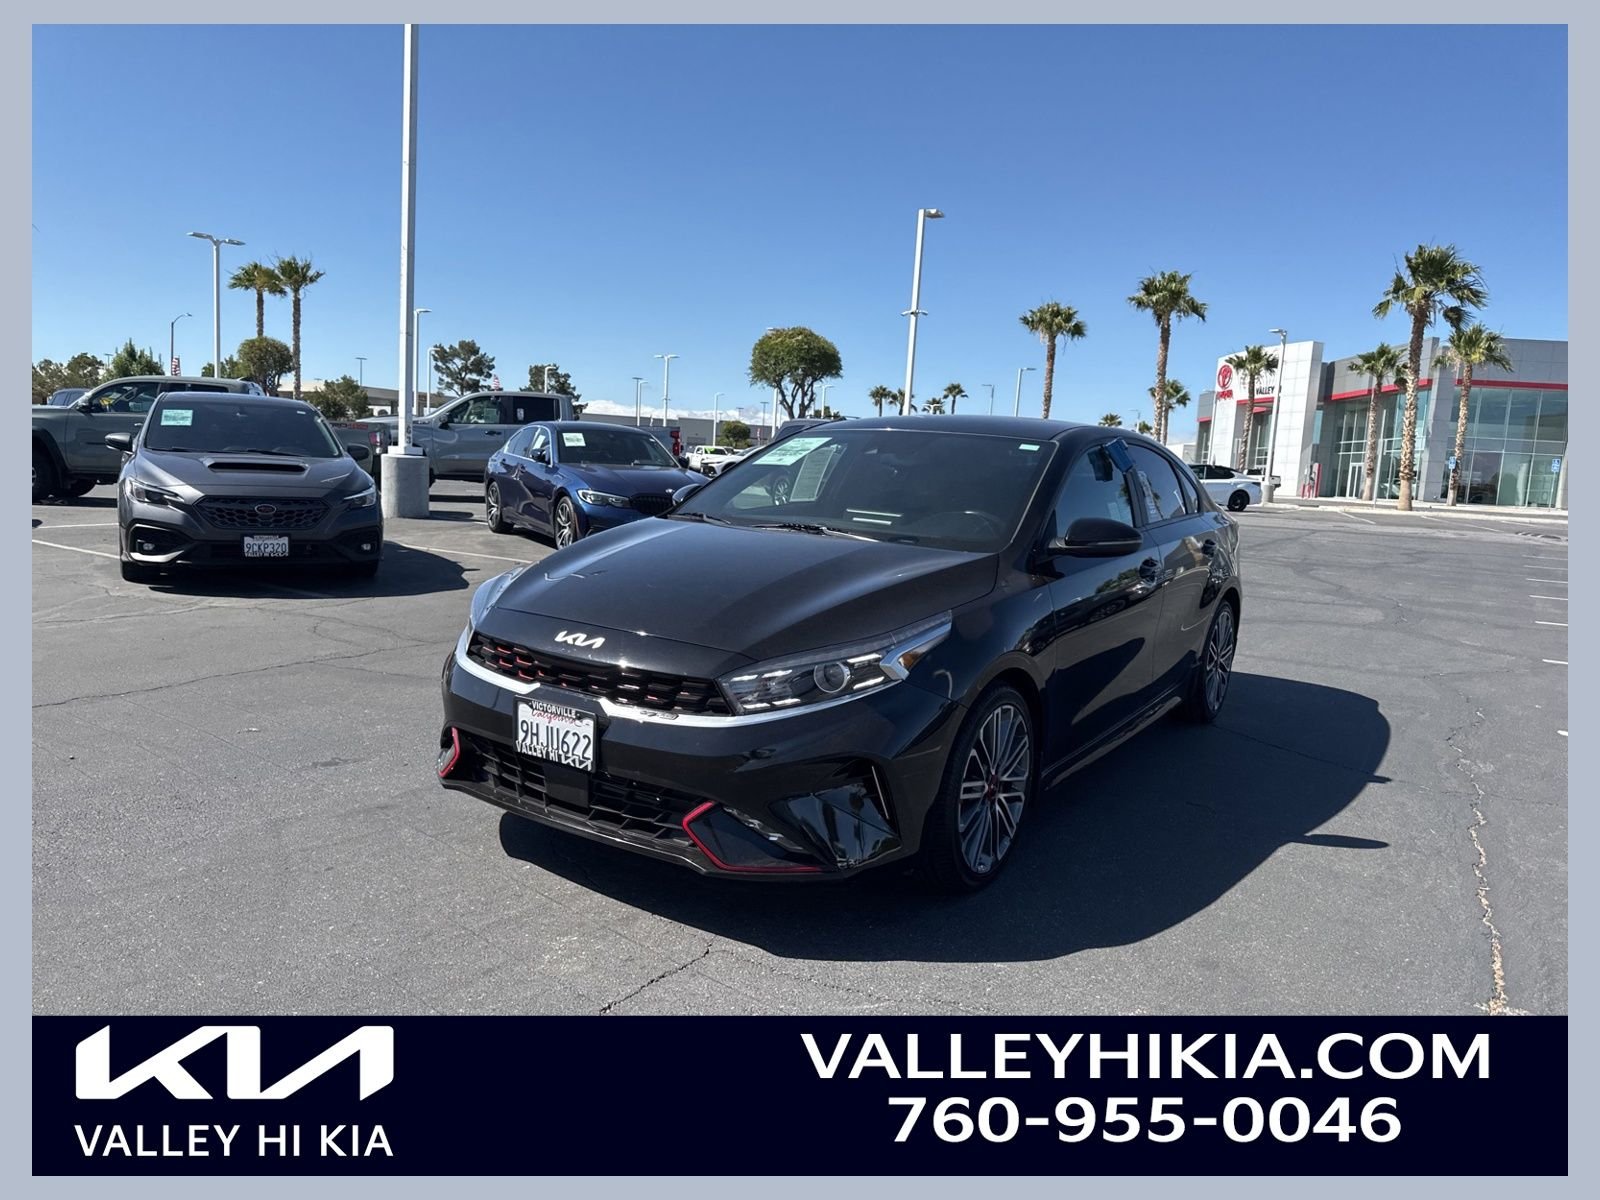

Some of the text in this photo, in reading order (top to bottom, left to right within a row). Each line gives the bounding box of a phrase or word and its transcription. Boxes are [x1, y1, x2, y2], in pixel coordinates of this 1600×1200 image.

[1256, 386, 1275, 395] VALLEY
[245, 542, 288, 553] 9CKP320
[531, 700, 577, 718] VICTORVILLE
[520, 719, 592, 760] 9HJU622
[515, 740, 548, 760] VALLEY
[548, 749, 559, 762] HI
